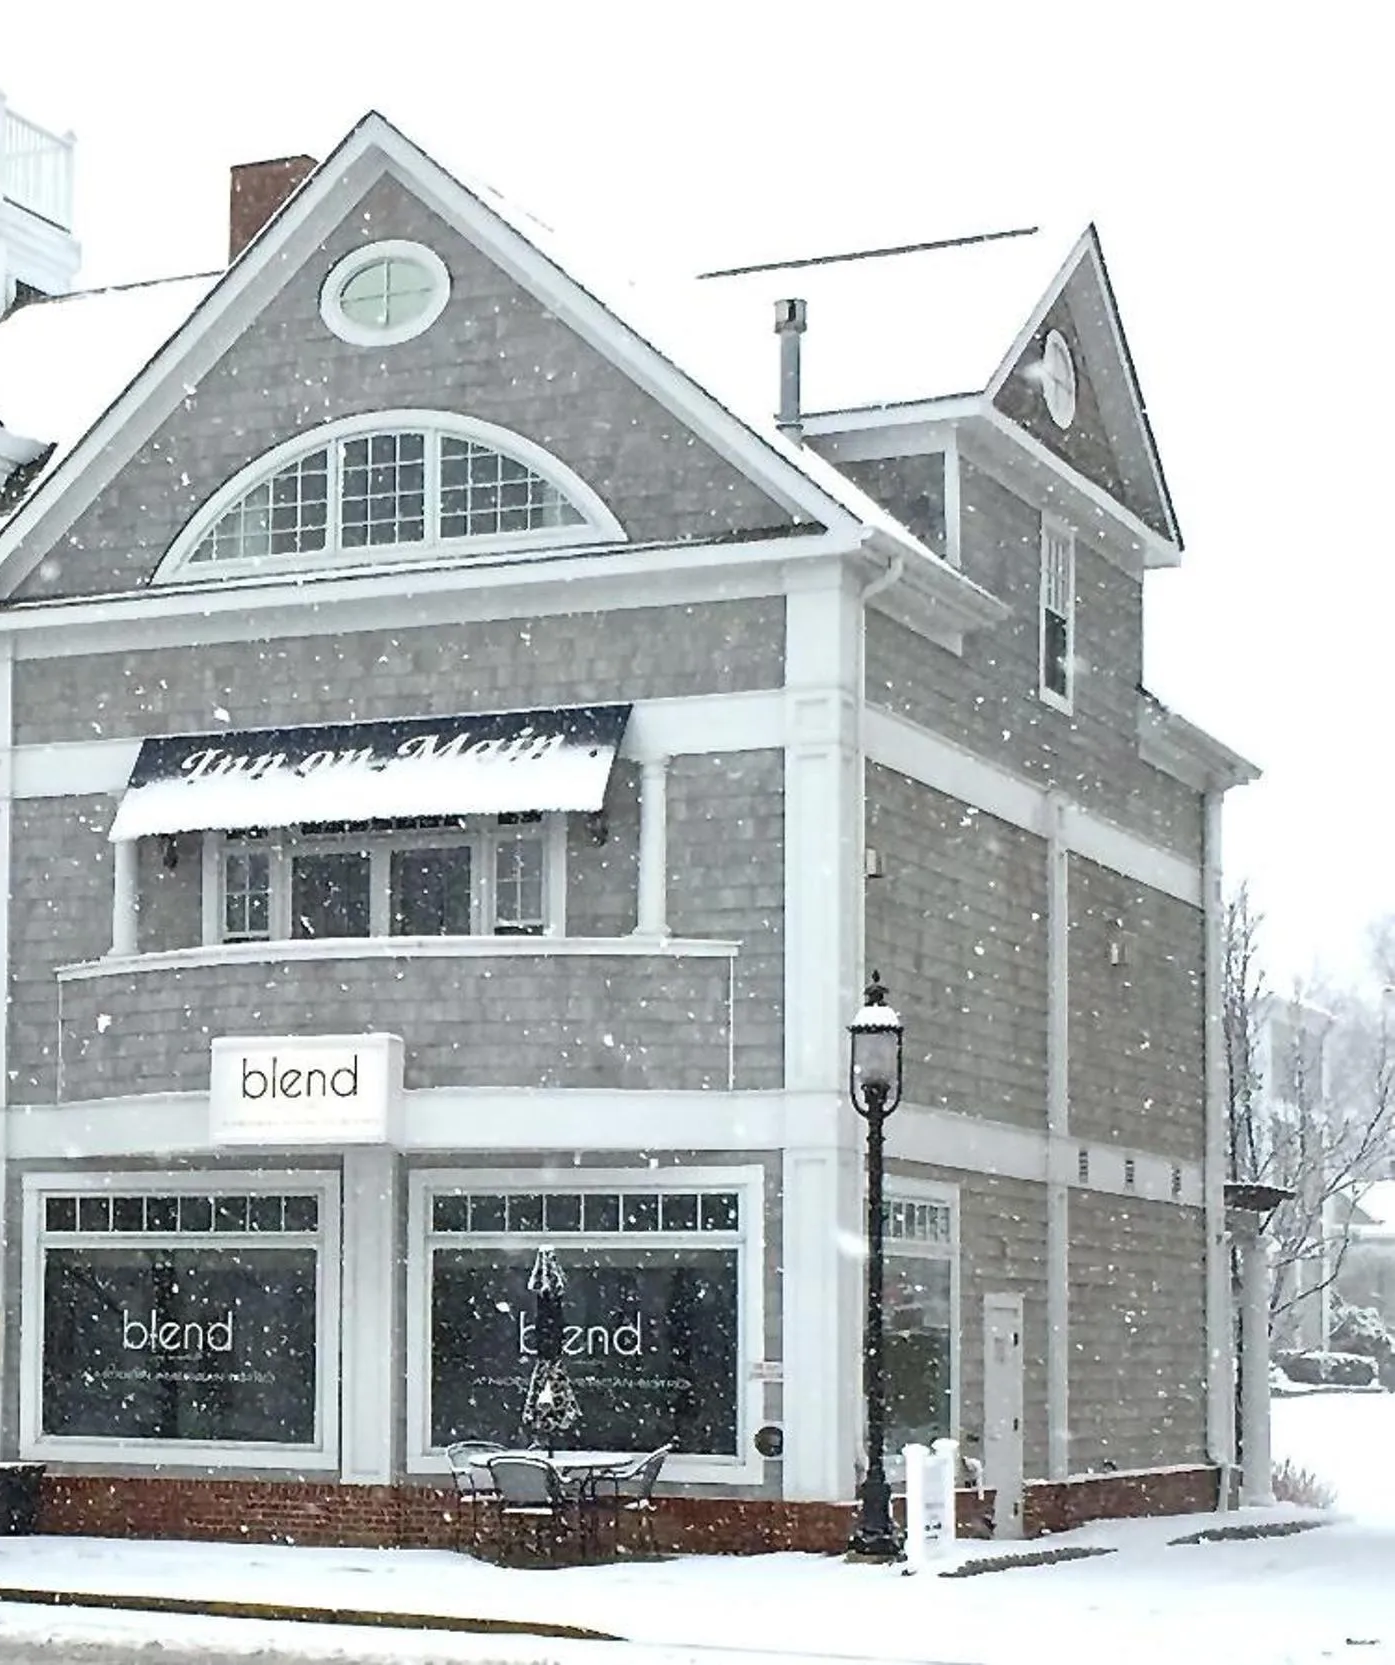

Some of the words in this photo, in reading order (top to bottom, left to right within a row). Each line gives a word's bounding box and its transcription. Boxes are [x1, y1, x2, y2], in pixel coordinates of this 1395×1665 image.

[181, 749, 286, 782] Inn
[300, 746, 374, 774] on
[397, 727, 566, 764] Main
[242, 1054, 358, 1099] blend
[123, 1309, 233, 1351] blend
[519, 1311, 642, 1355] bend
